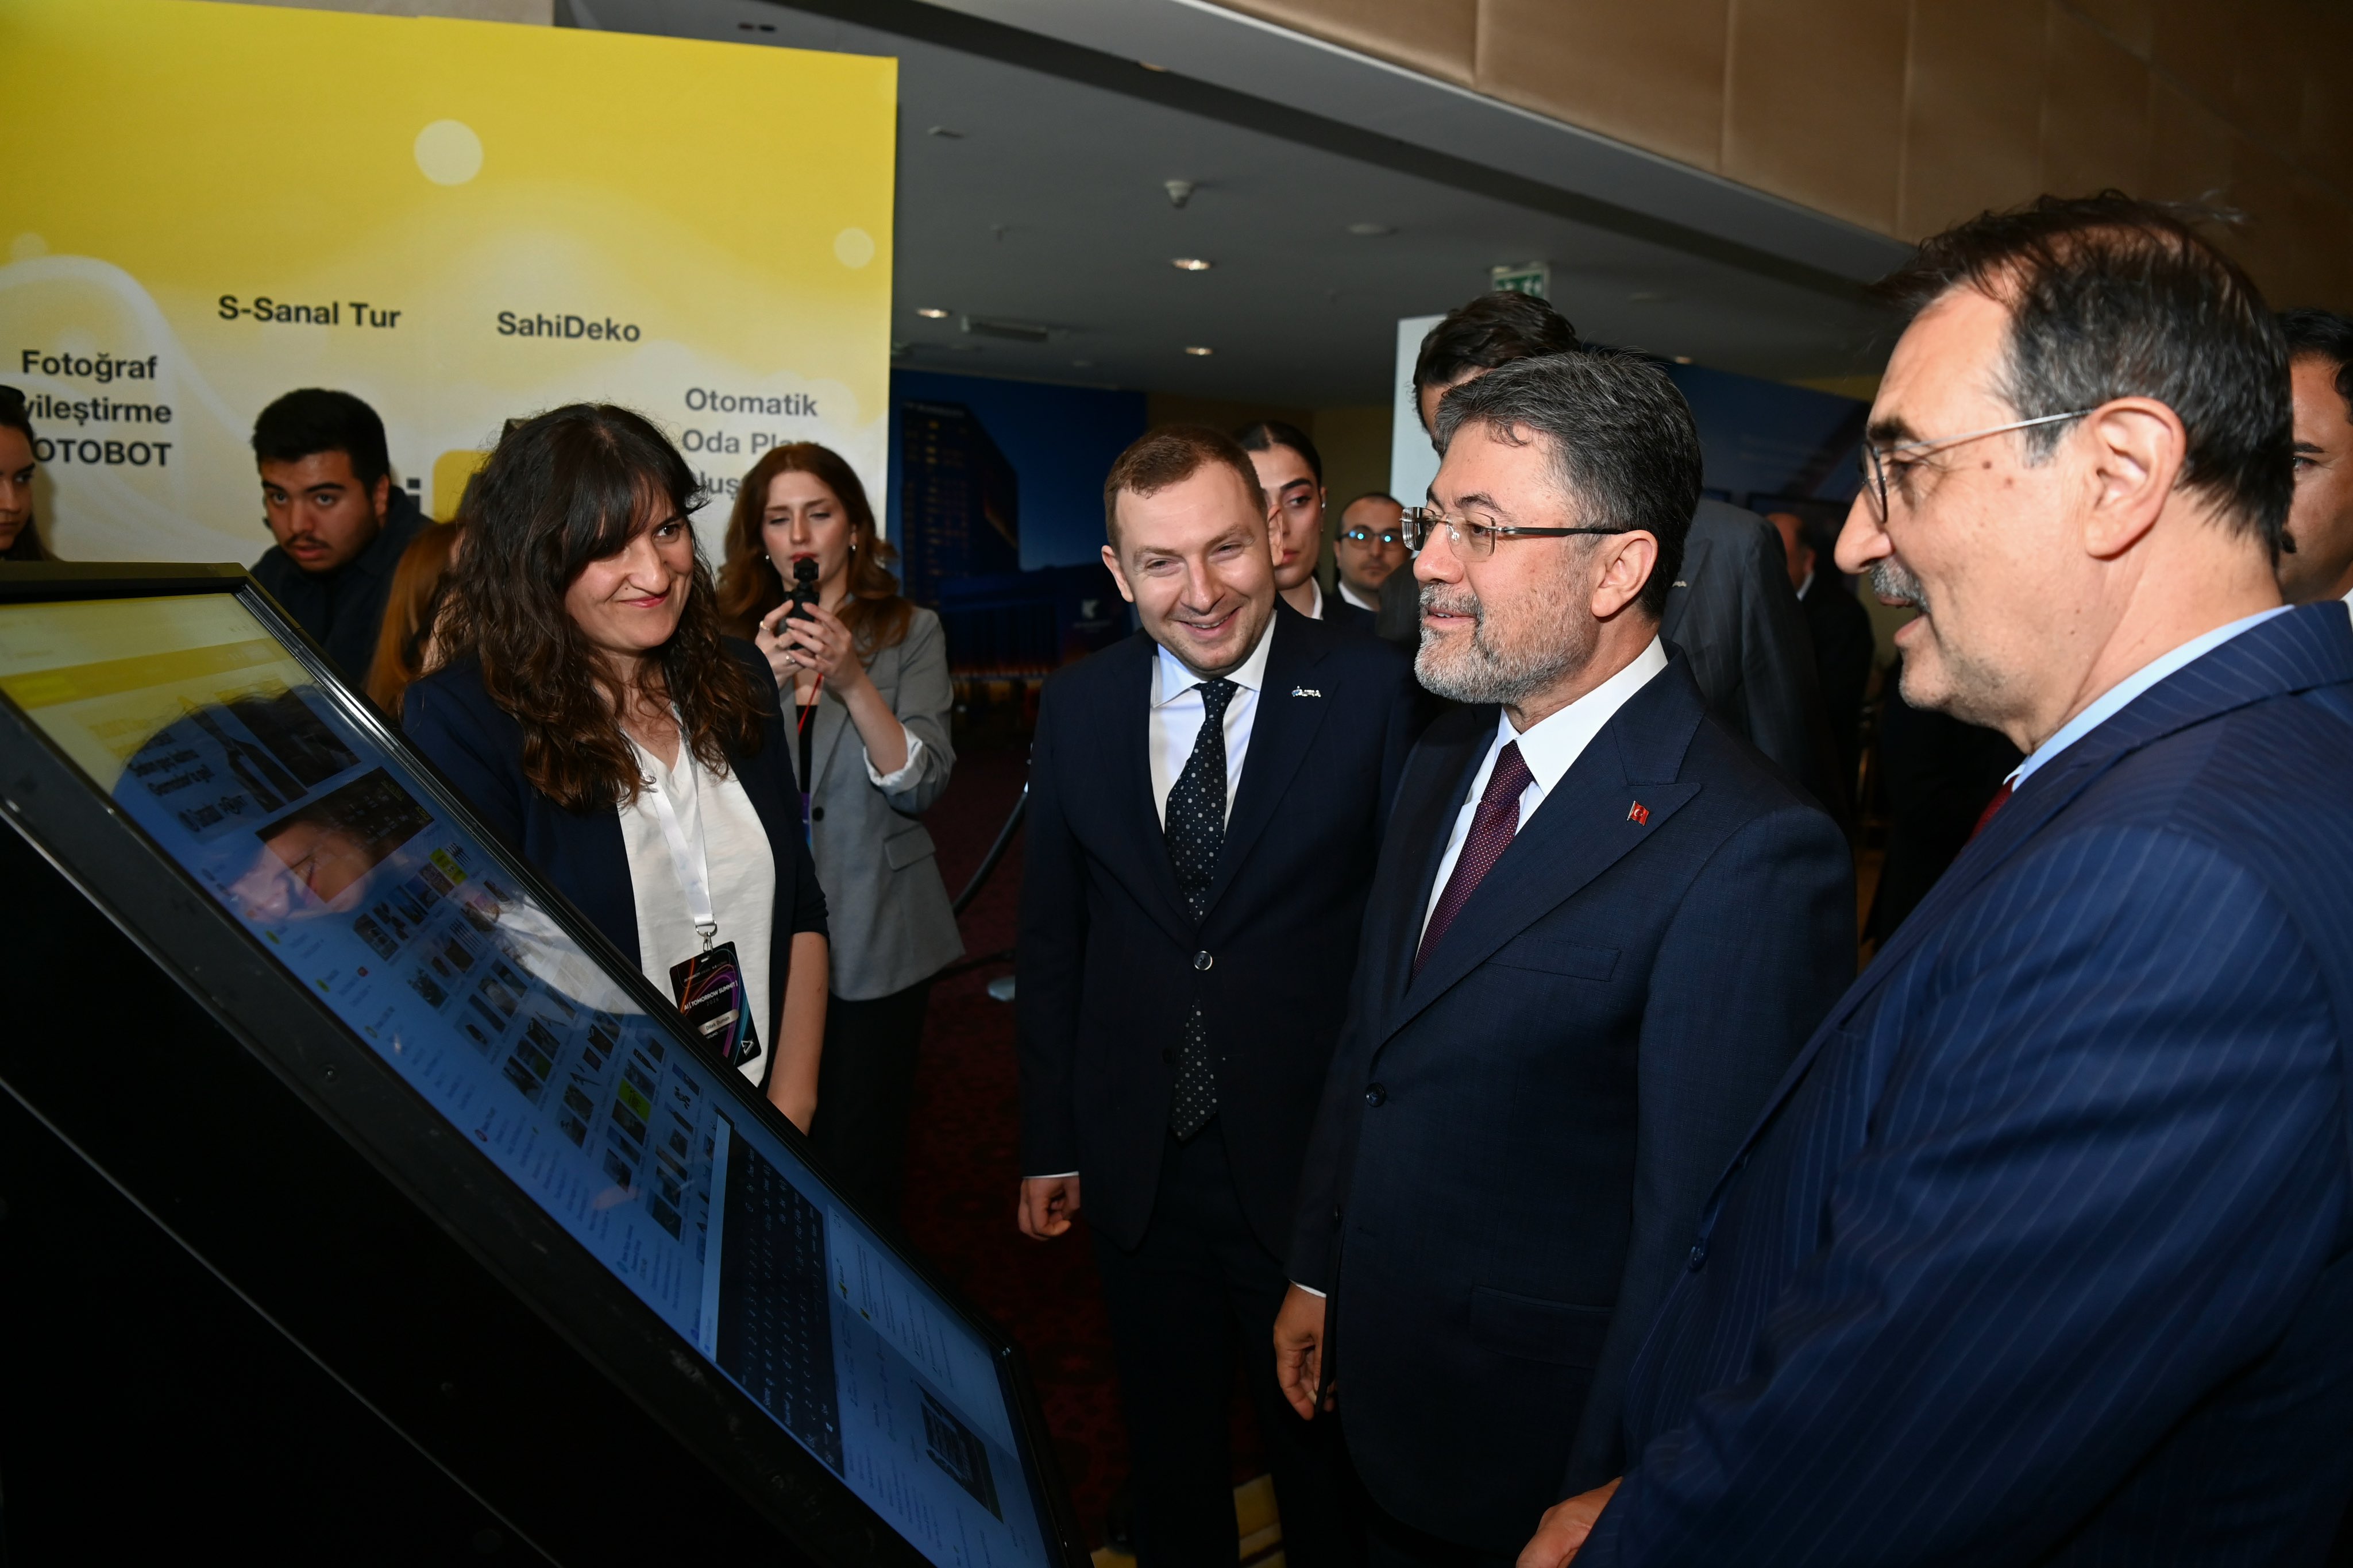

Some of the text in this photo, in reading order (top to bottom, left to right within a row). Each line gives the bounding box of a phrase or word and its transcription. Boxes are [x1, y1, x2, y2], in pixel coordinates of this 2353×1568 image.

[218, 295, 401, 328] S-Sanal Tur
[497, 311, 641, 342] SahiDeko
[22, 349, 157, 383] Fotoğraf
[685, 387, 817, 416] Otomatik
[34, 437, 172, 466] OTOBOT
[681, 429, 740, 454] Oda
